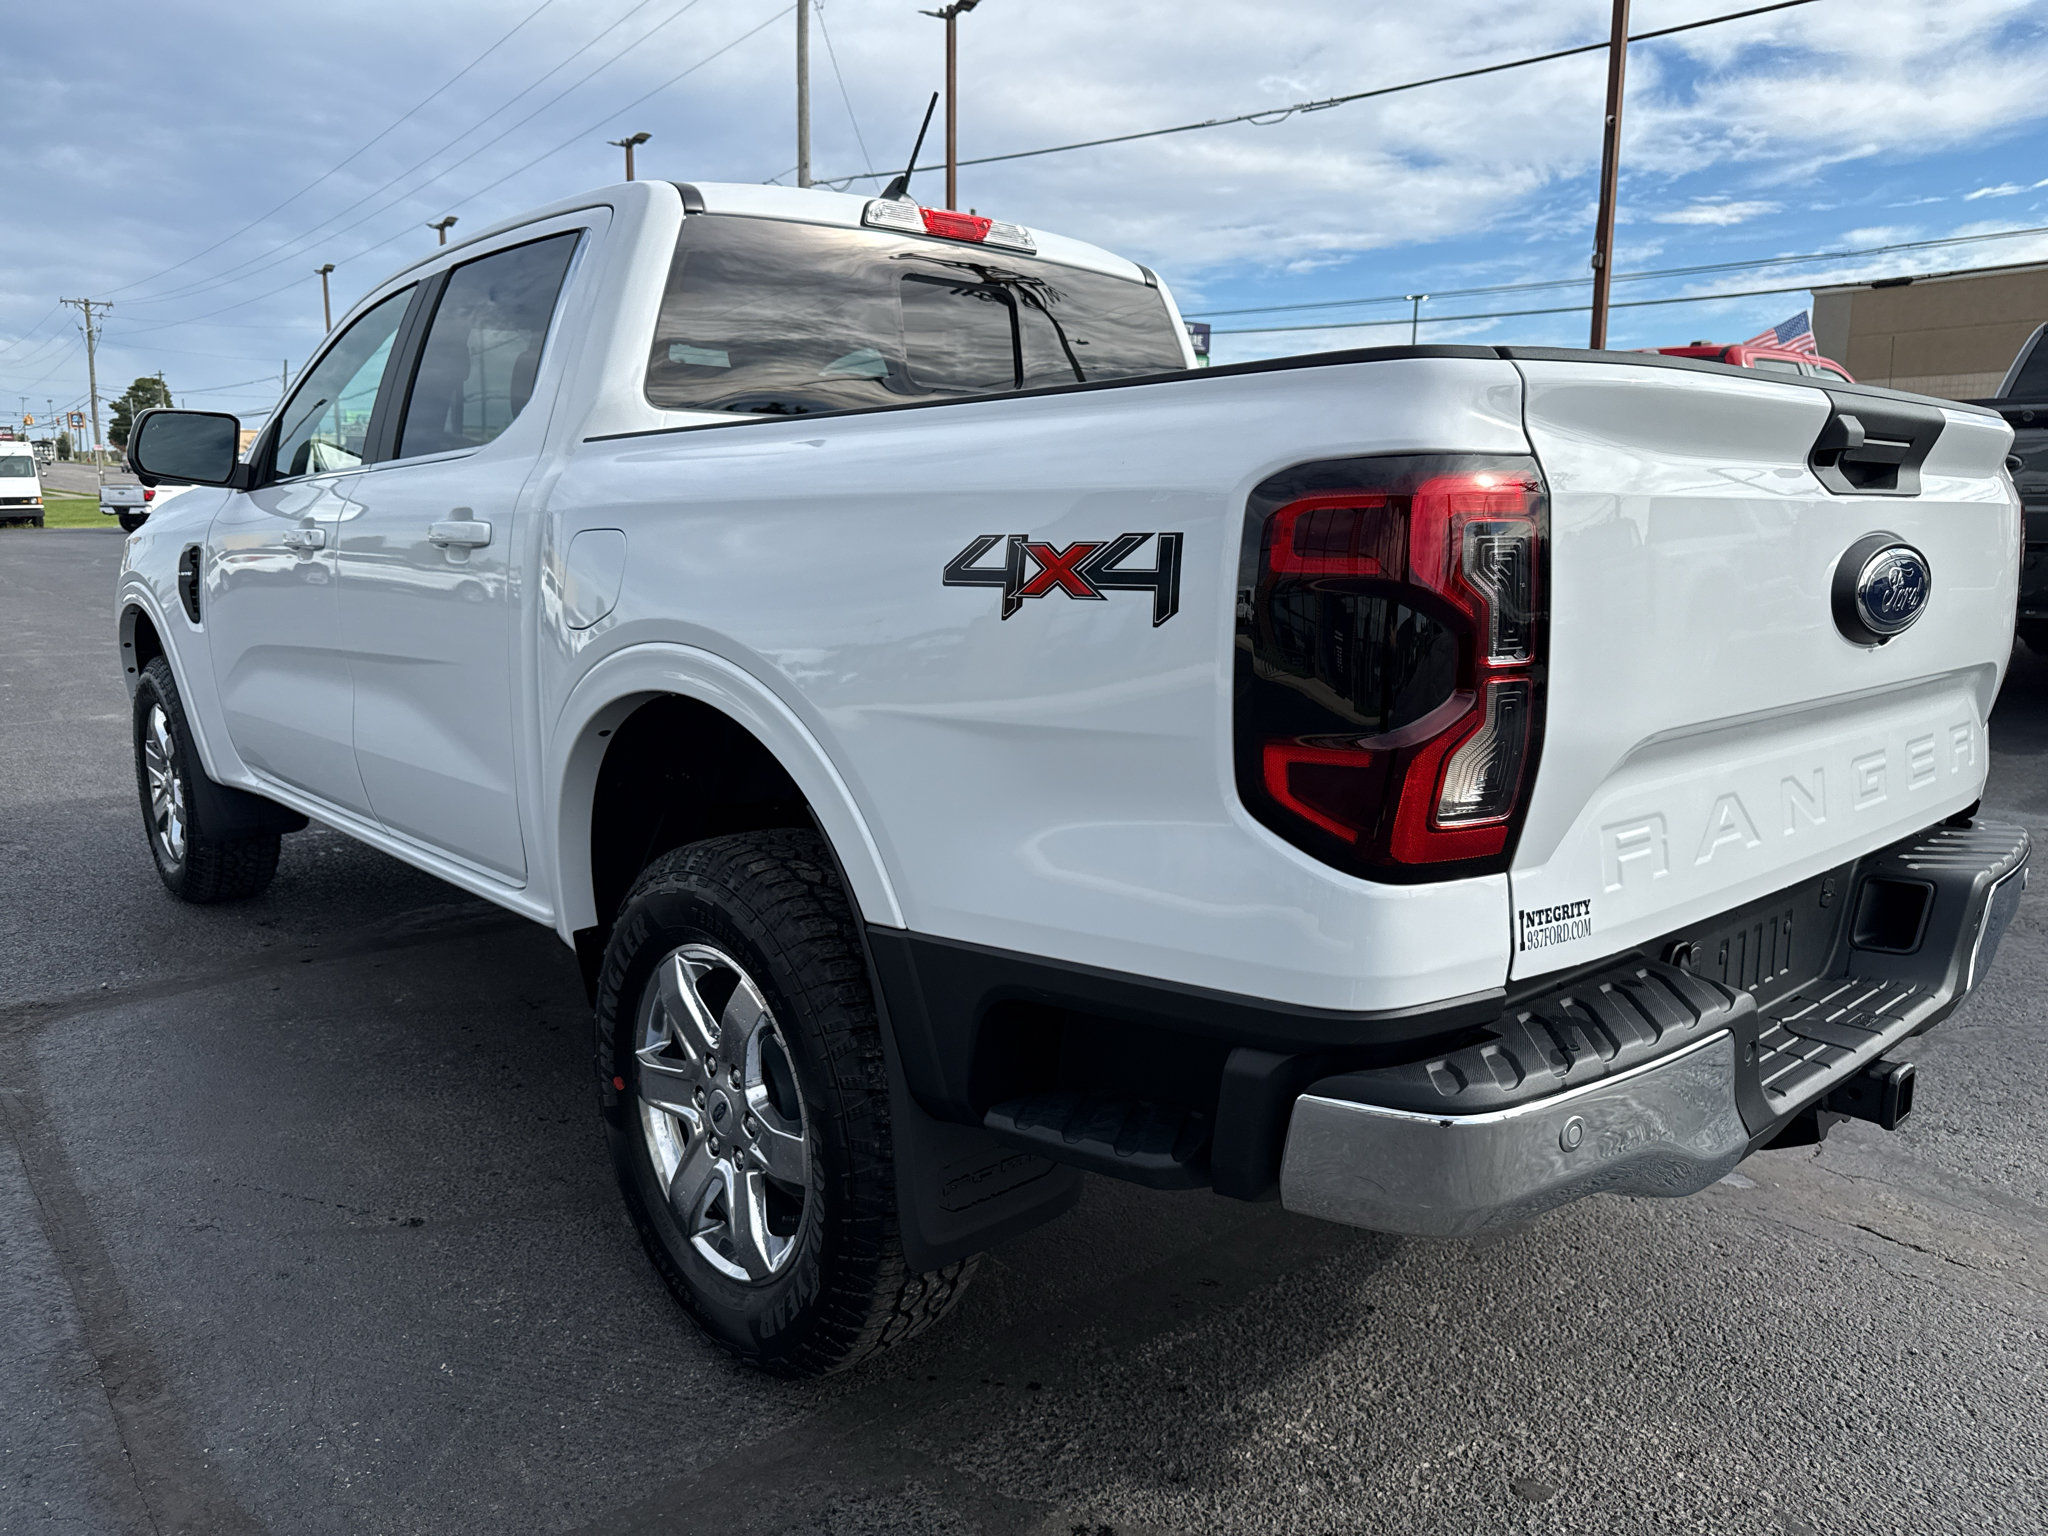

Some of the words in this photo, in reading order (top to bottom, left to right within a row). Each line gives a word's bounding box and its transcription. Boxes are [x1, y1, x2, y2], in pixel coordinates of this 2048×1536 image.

[1881, 566, 1922, 613] Ford
[1600, 720, 1975, 894] RANGER
[1518, 898, 1591, 952] INTEGRITY
[1526, 917, 1592, 951] 937FORD.COM
[599, 912, 651, 1107] WRANGLER
[759, 1123, 826, 1339] GOODYEAR
